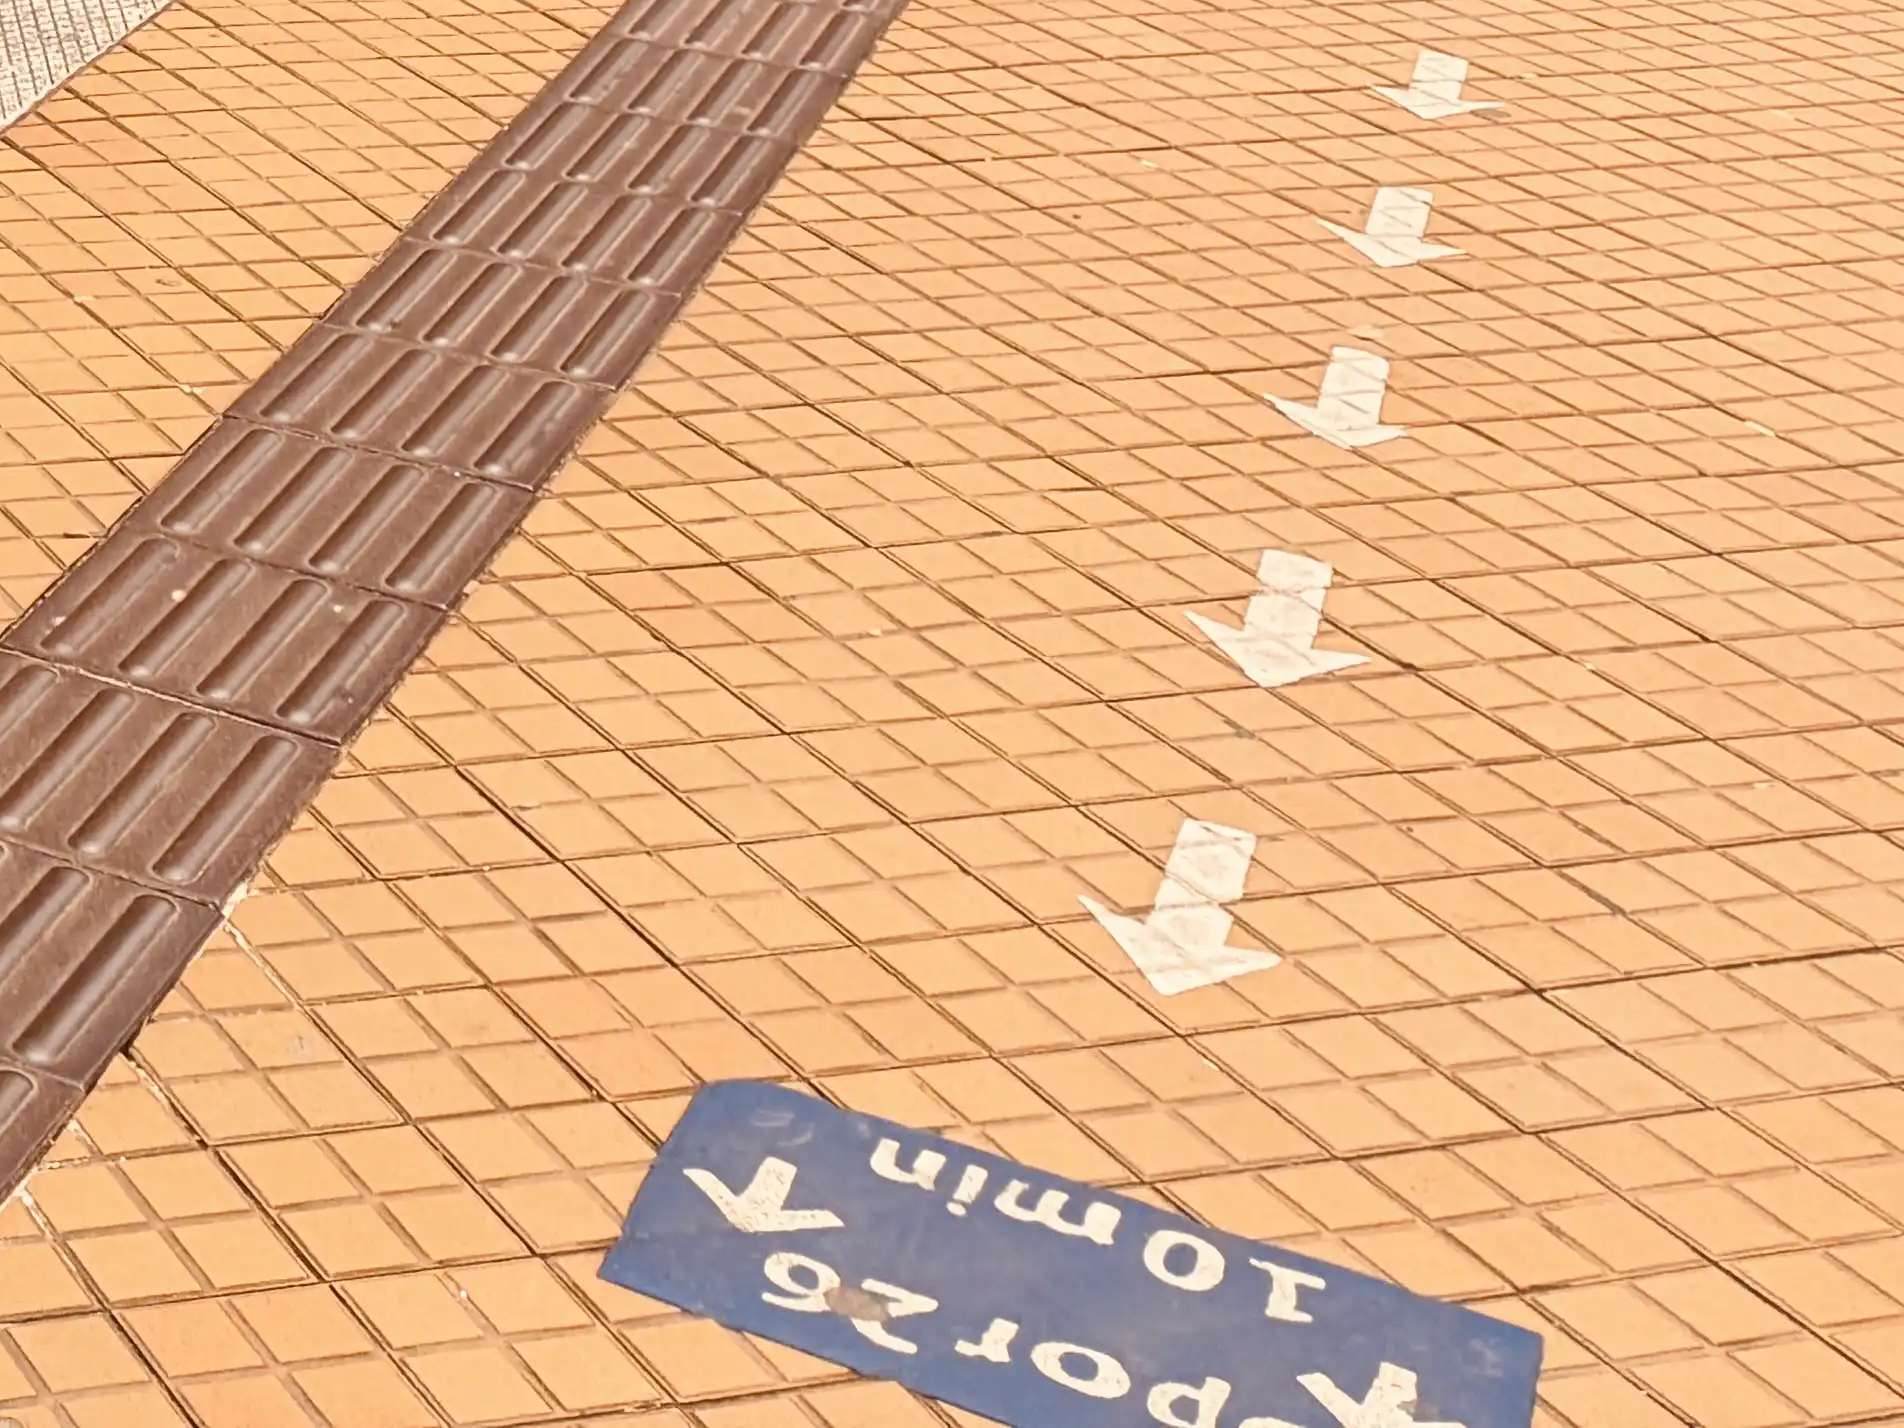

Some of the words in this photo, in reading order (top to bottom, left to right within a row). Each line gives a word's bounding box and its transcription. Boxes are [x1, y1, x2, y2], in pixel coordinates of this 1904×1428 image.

[870, 1138, 1122, 1245] min
[761, 1251, 939, 1354] 26
[1142, 1229, 1326, 1324] 10
[955, 1318, 1300, 1428] por
